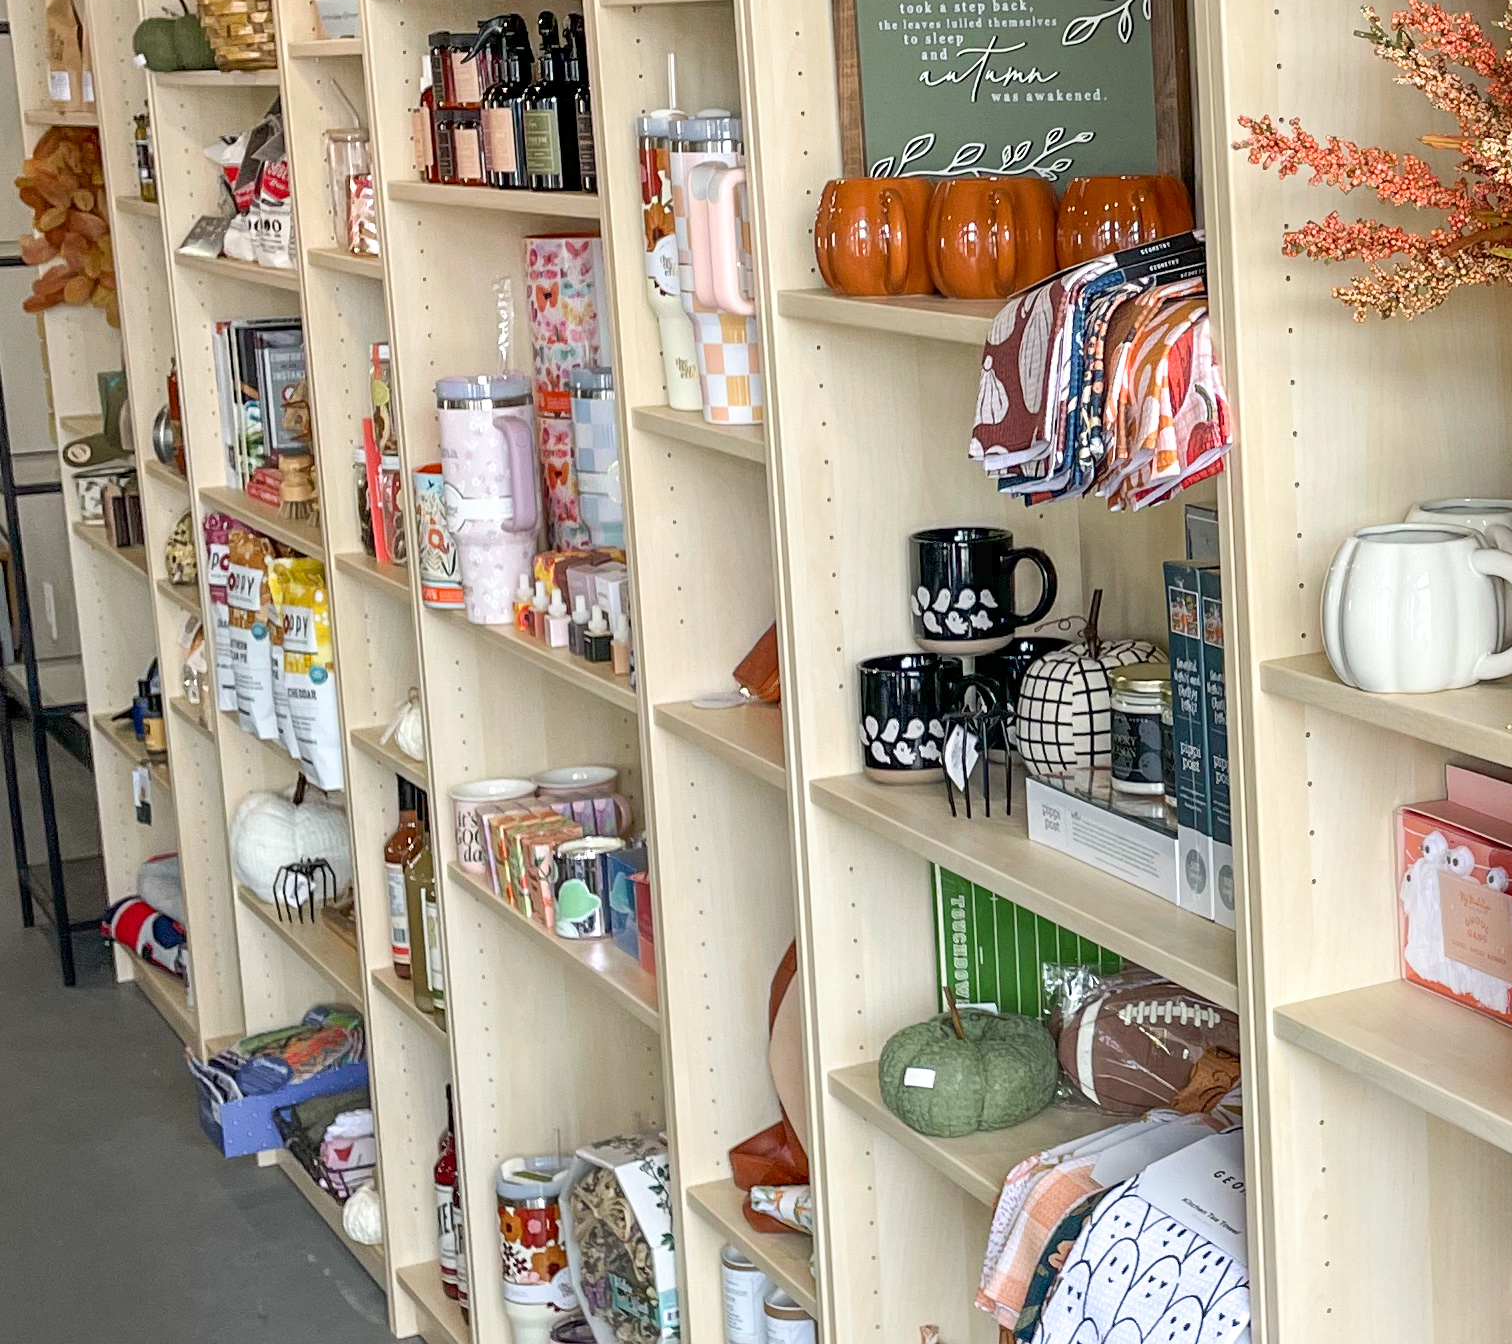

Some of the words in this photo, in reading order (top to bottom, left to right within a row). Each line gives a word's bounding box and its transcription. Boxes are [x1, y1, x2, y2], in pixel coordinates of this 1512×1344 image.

[900, 1, 932, 14] took
[940, 3, 947, 13] a
[954, 0, 986, 15] step
[992, 0, 1034, 13] back,
[878, 20, 898, 31] the
[903, 18, 942, 30] leaves
[947, 18, 983, 29] lulled
[988, 17, 1058, 28] themselves
[904, 33, 918, 45] to
[925, 32, 964, 47] sleep
[921, 49, 948, 61] and
[919, 35, 1060, 103] autumn
[991, 92, 1019, 103] was
[1026, 88, 1108, 103] awakened.
[283, 612, 309, 636] OPPY
[1179, 741, 1202, 759] pippi
[1182, 756, 1201, 773] post
[1212, 755, 1228, 771] pip
[1215, 771, 1229, 785] pos
